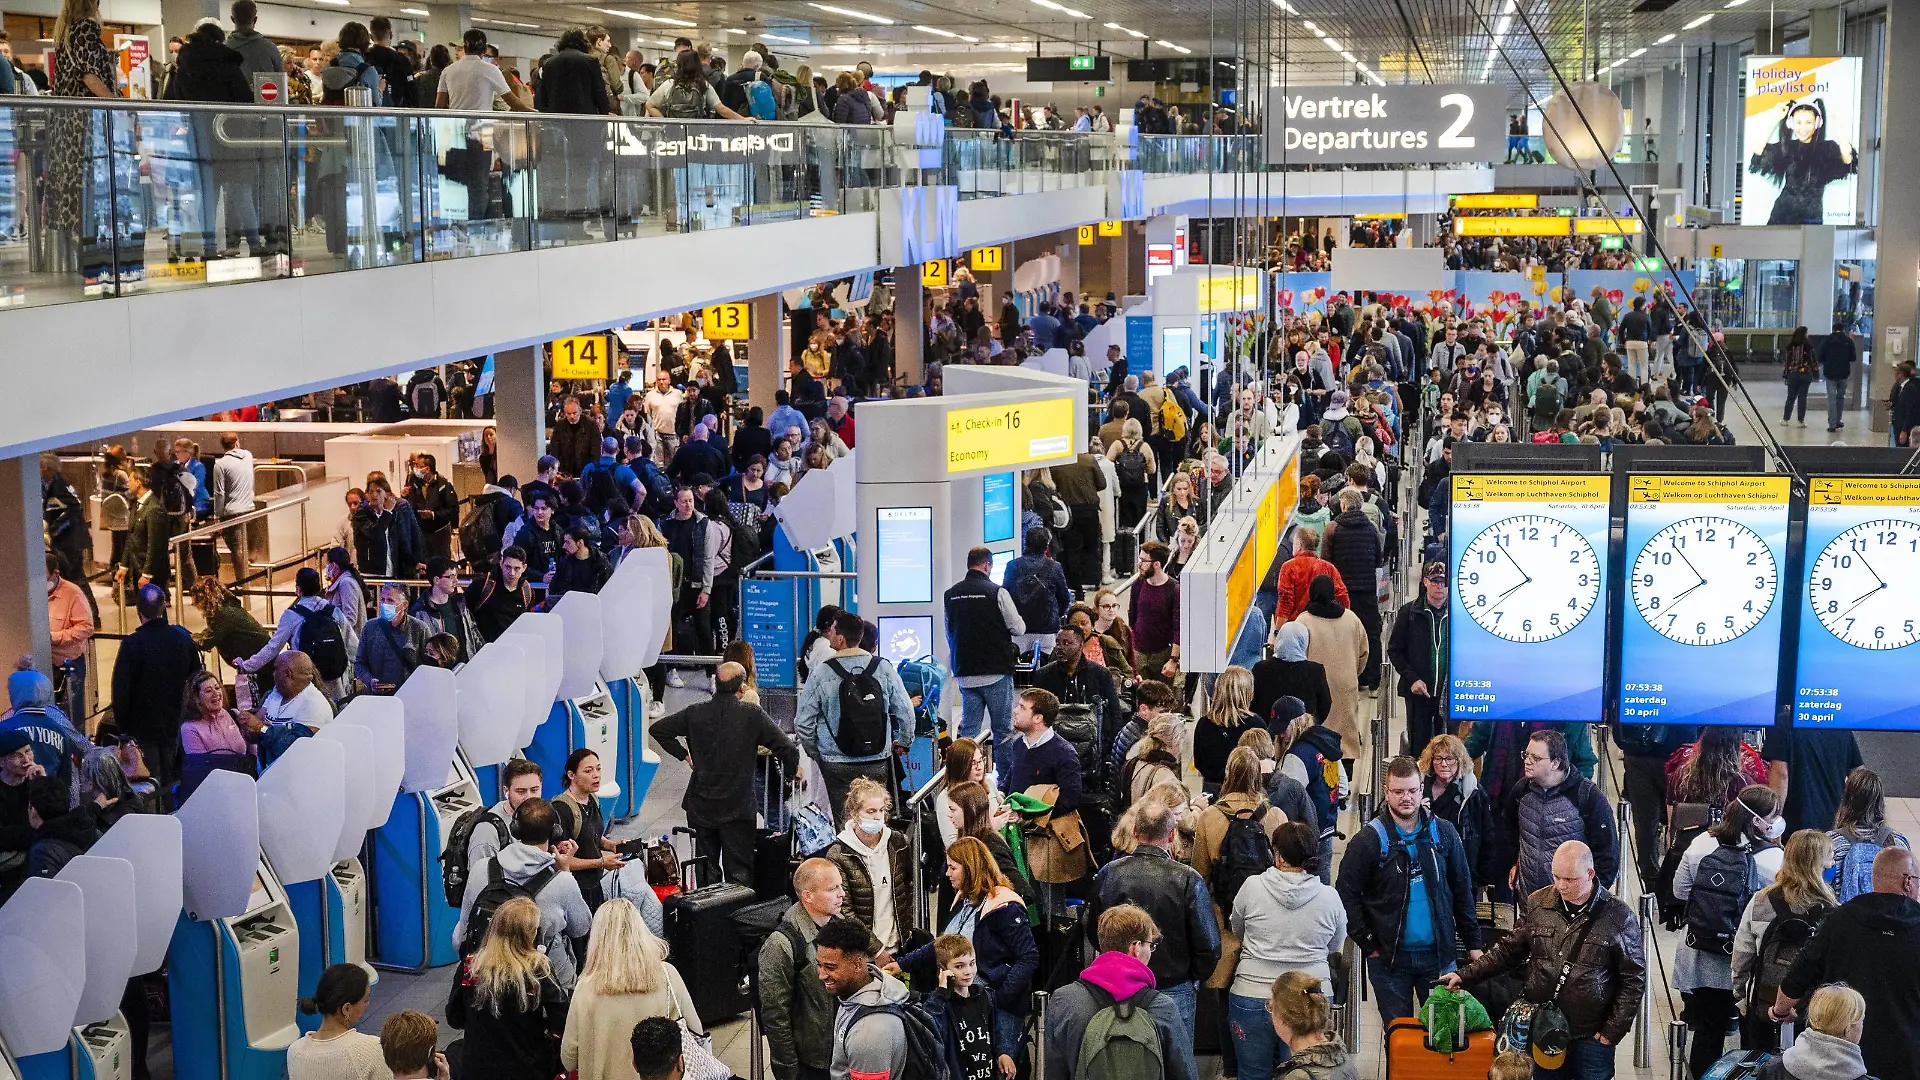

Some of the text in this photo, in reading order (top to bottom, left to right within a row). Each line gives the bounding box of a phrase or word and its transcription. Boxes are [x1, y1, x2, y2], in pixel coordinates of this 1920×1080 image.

[1752, 68, 1802, 81] Holiday
[1758, 82, 1828, 95] playlist on!
[1283, 93, 1387, 118] Vertrek
[1438, 93, 1476, 148] 2
[1285, 127, 1427, 154] Departures
[901, 186, 958, 267] KLM
[978, 250, 995, 263] 11
[1714, 246, 1719, 256] F
[921, 262, 940, 278] 12
[712, 307, 740, 328] 13
[563, 340, 597, 365] 14
[966, 410, 1020, 430] Check-in 16
[950, 450, 989, 462] Economy
[1519, 527, 1538, 540] 12
[1696, 529, 1715, 541] 12
[1877, 532, 1897, 545] 12
[1494, 534, 1510, 546] 11
[1551, 535, 1557, 547] 1
[1670, 536, 1686, 548] 11
[1728, 536, 1734, 549] 1
[1850, 539, 1866, 551] 11
[1910, 540, 1916, 552] 1
[1477, 550, 1496, 563] 10
[1570, 551, 1579, 563] 2
[1652, 552, 1672, 565] 10
[1747, 552, 1757, 565] 2
[1832, 555, 1851, 568] 10
[1470, 572, 1479, 584] 9
[1578, 574, 1588, 586] 3
[1644, 574, 1653, 587] 9
[1755, 577, 1765, 589] 3
[1822, 578, 1832, 590] 9
[1477, 595, 1486, 607] 8
[1568, 598, 1577, 610] 4
[1650, 597, 1660, 609] 8
[1743, 600, 1752, 612] 4
[1828, 600, 1838, 613] 8
[1494, 612, 1504, 624] 7
[1550, 613, 1559, 625] 5
[1668, 614, 1677, 626] 7
[1725, 616, 1734, 628] 5
[1846, 618, 1855, 630] 7
[1522, 620, 1532, 632] 6
[1696, 622, 1706, 634] 6
[1903, 620, 1913, 633] 5
[719, 616, 728, 649] adidas
[1875, 626, 1884, 639] 6
[1454, 680, 1492, 688] 07:53:38
[1624, 683, 1663, 692] 07:53:38
[1454, 692, 1496, 702] zaterdag
[1800, 688, 1839, 696] 07:53:38
[1624, 696, 1667, 706] zaterdag
[1799, 701, 1842, 710] zaterdag
[1454, 704, 1488, 714] 30 april
[1637, 708, 1659, 718] april
[1812, 714, 1834, 722] april
[36, 726, 64, 754] YORK
